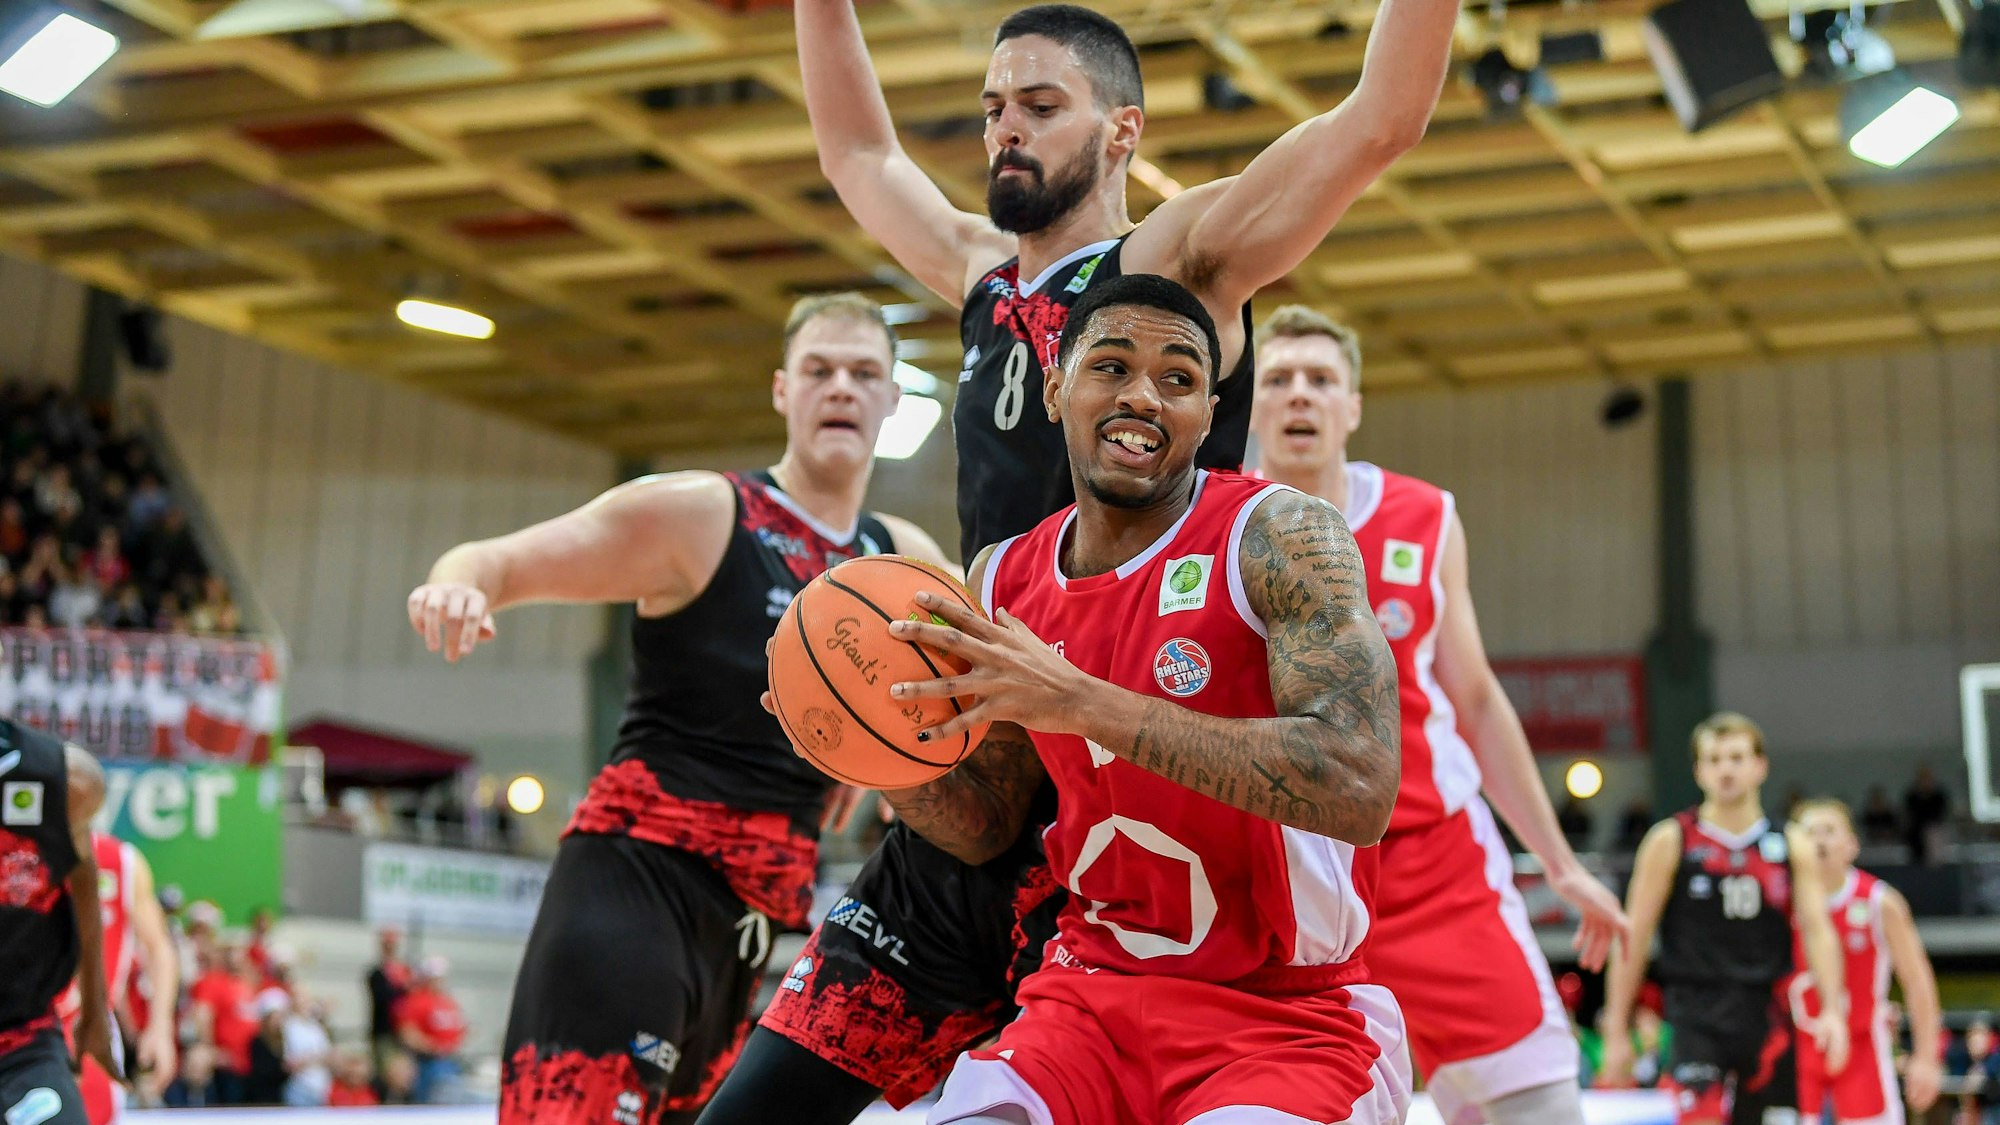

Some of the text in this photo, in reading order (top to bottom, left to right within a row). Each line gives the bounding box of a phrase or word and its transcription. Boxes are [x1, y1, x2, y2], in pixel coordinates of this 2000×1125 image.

[994, 342, 1028, 431] 8
[1163, 597, 1201, 609] BARMER
[1156, 660, 1189, 679] RHEIN
[1173, 667, 1209, 686] STARS
[847, 903, 909, 966] EVL
